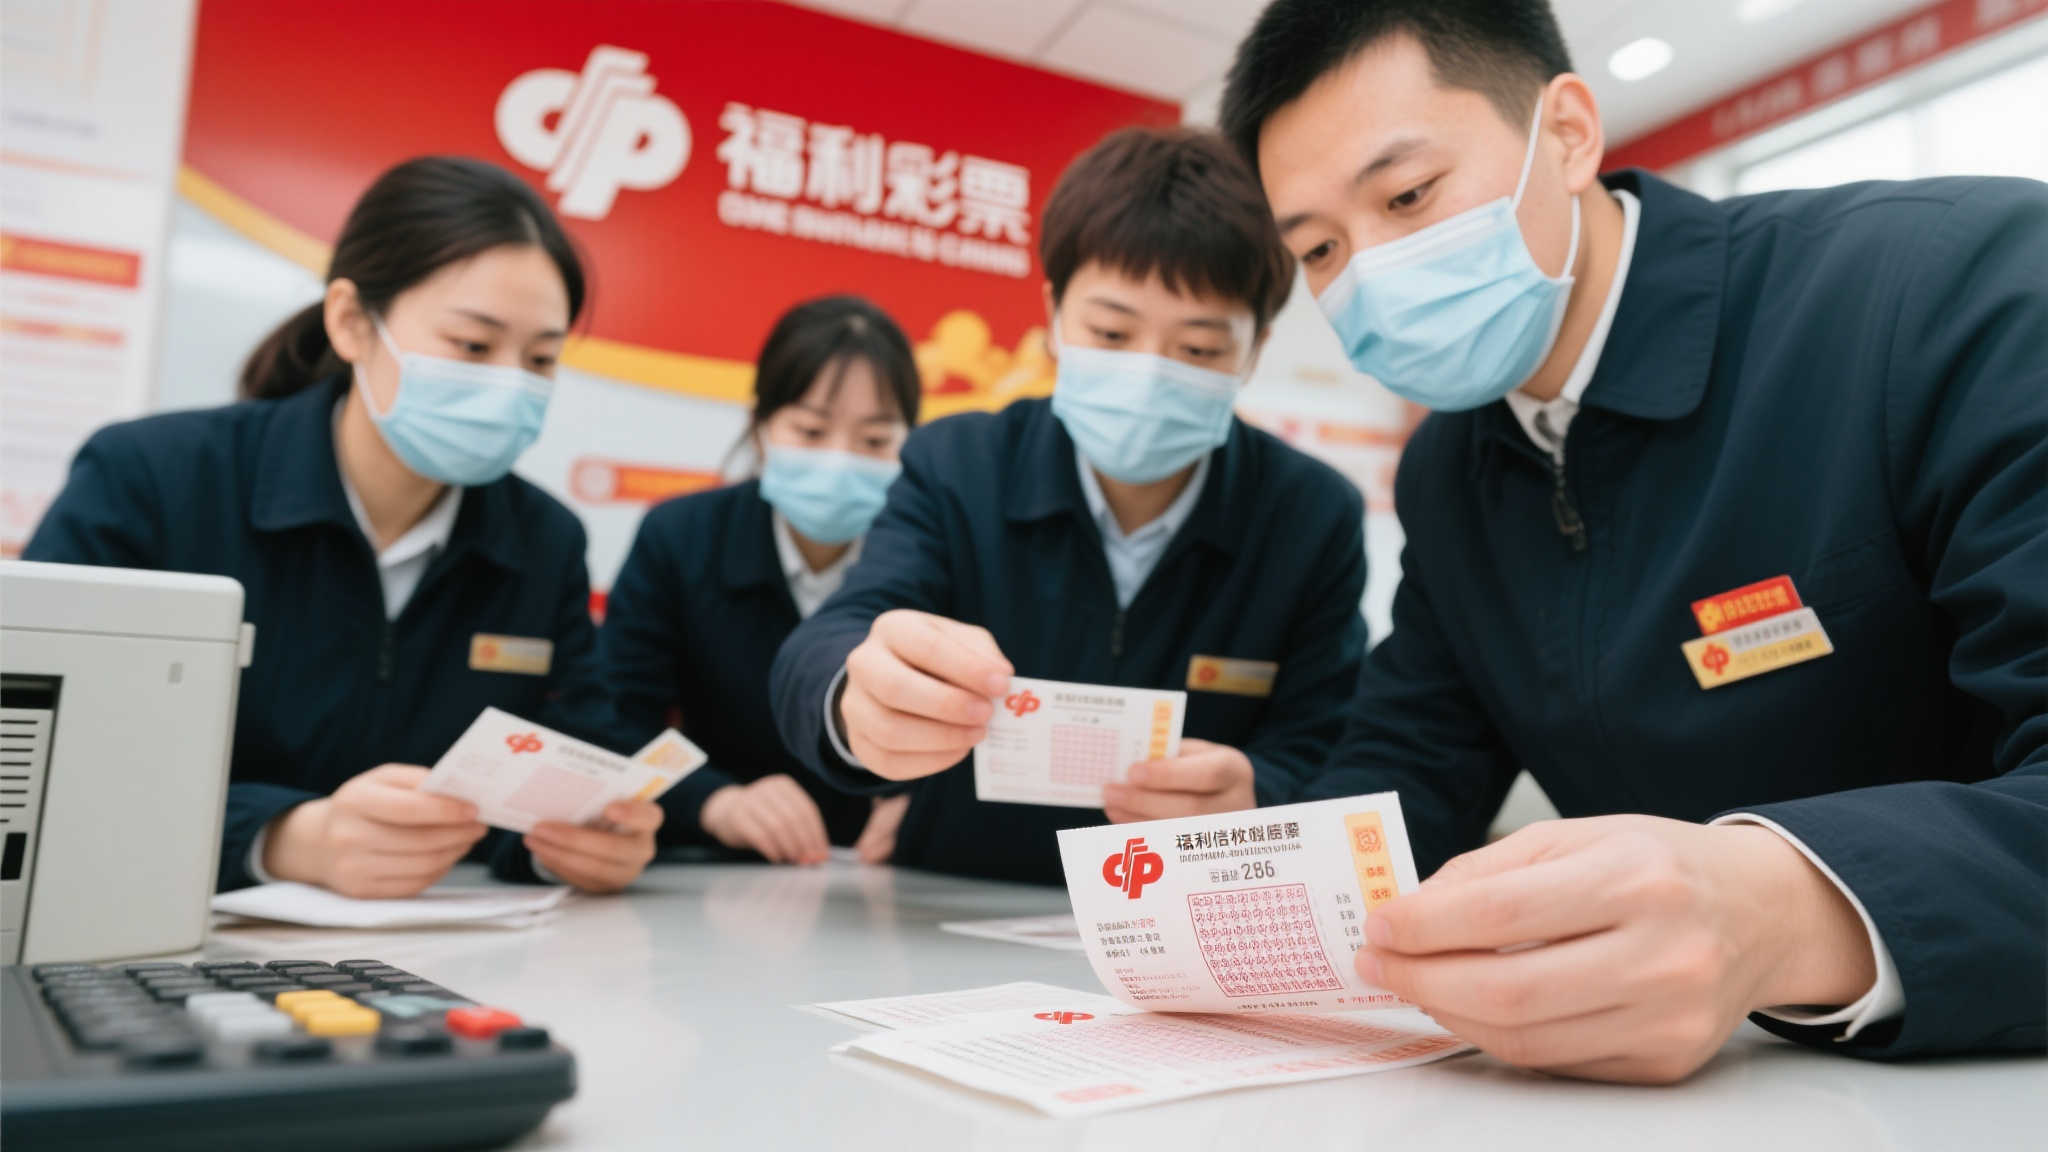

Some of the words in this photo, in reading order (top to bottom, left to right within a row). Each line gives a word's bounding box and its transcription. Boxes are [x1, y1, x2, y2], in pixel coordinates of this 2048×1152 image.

[717, 101, 1031, 244] 福利彩票
[1240, 860, 1276, 880] 286
